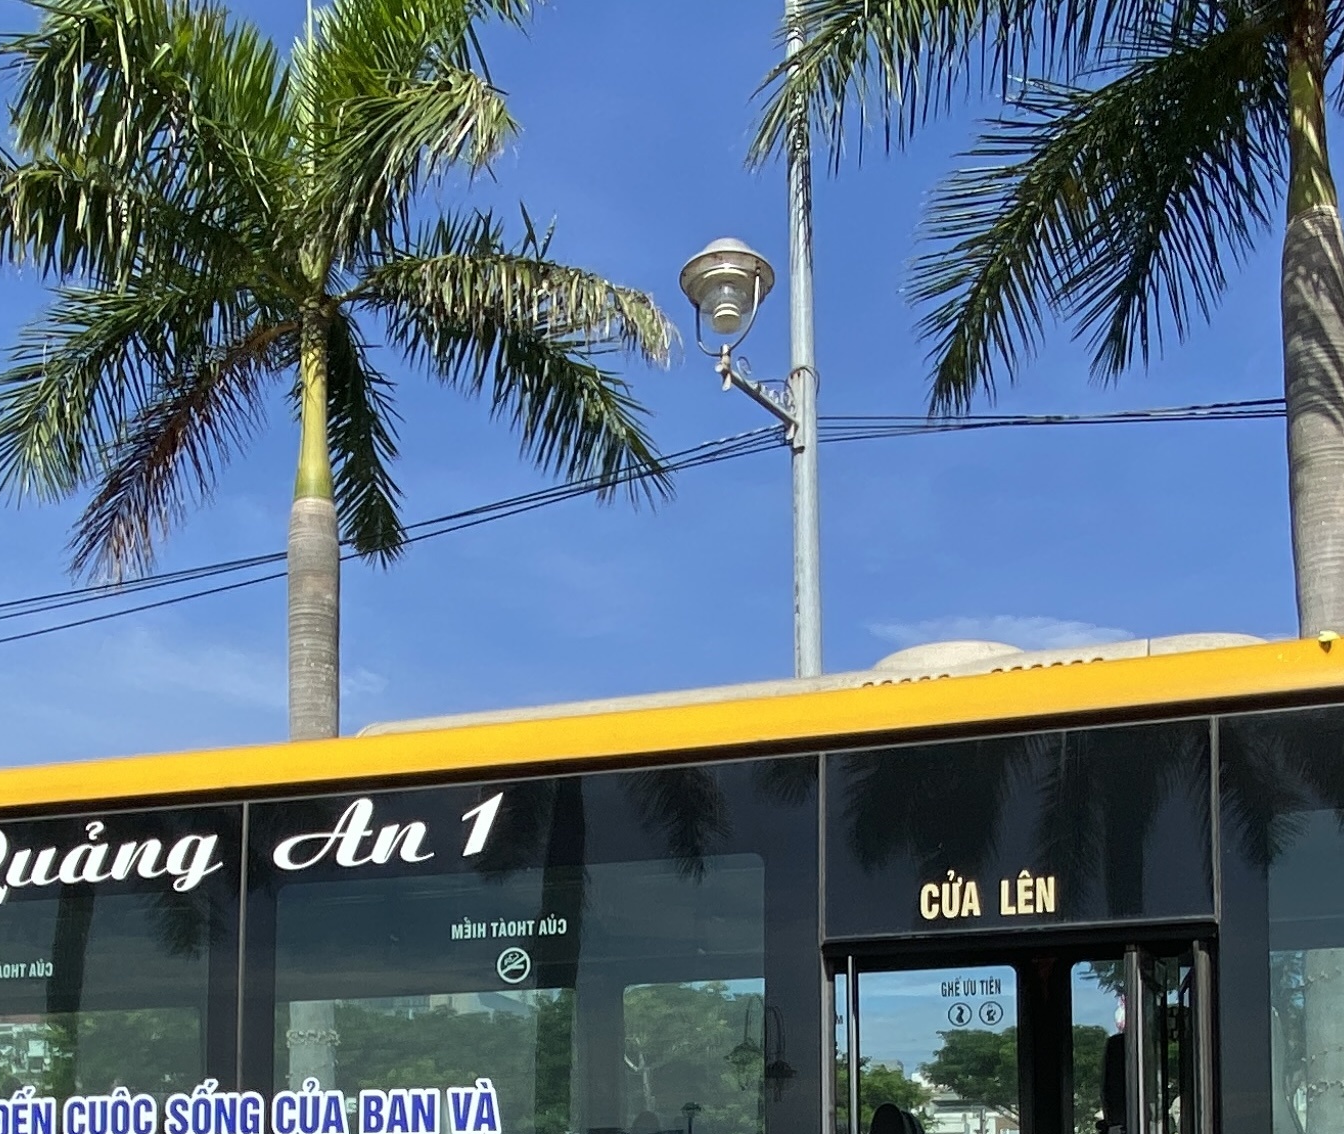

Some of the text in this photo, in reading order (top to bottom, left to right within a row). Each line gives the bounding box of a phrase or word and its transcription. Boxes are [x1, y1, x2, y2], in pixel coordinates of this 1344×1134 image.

[272, 797, 435, 871] An
[461, 792, 504, 857] 1
[920, 869, 1055, 920] CỬA LÊN
[450, 1080, 499, 1134] VÀ
